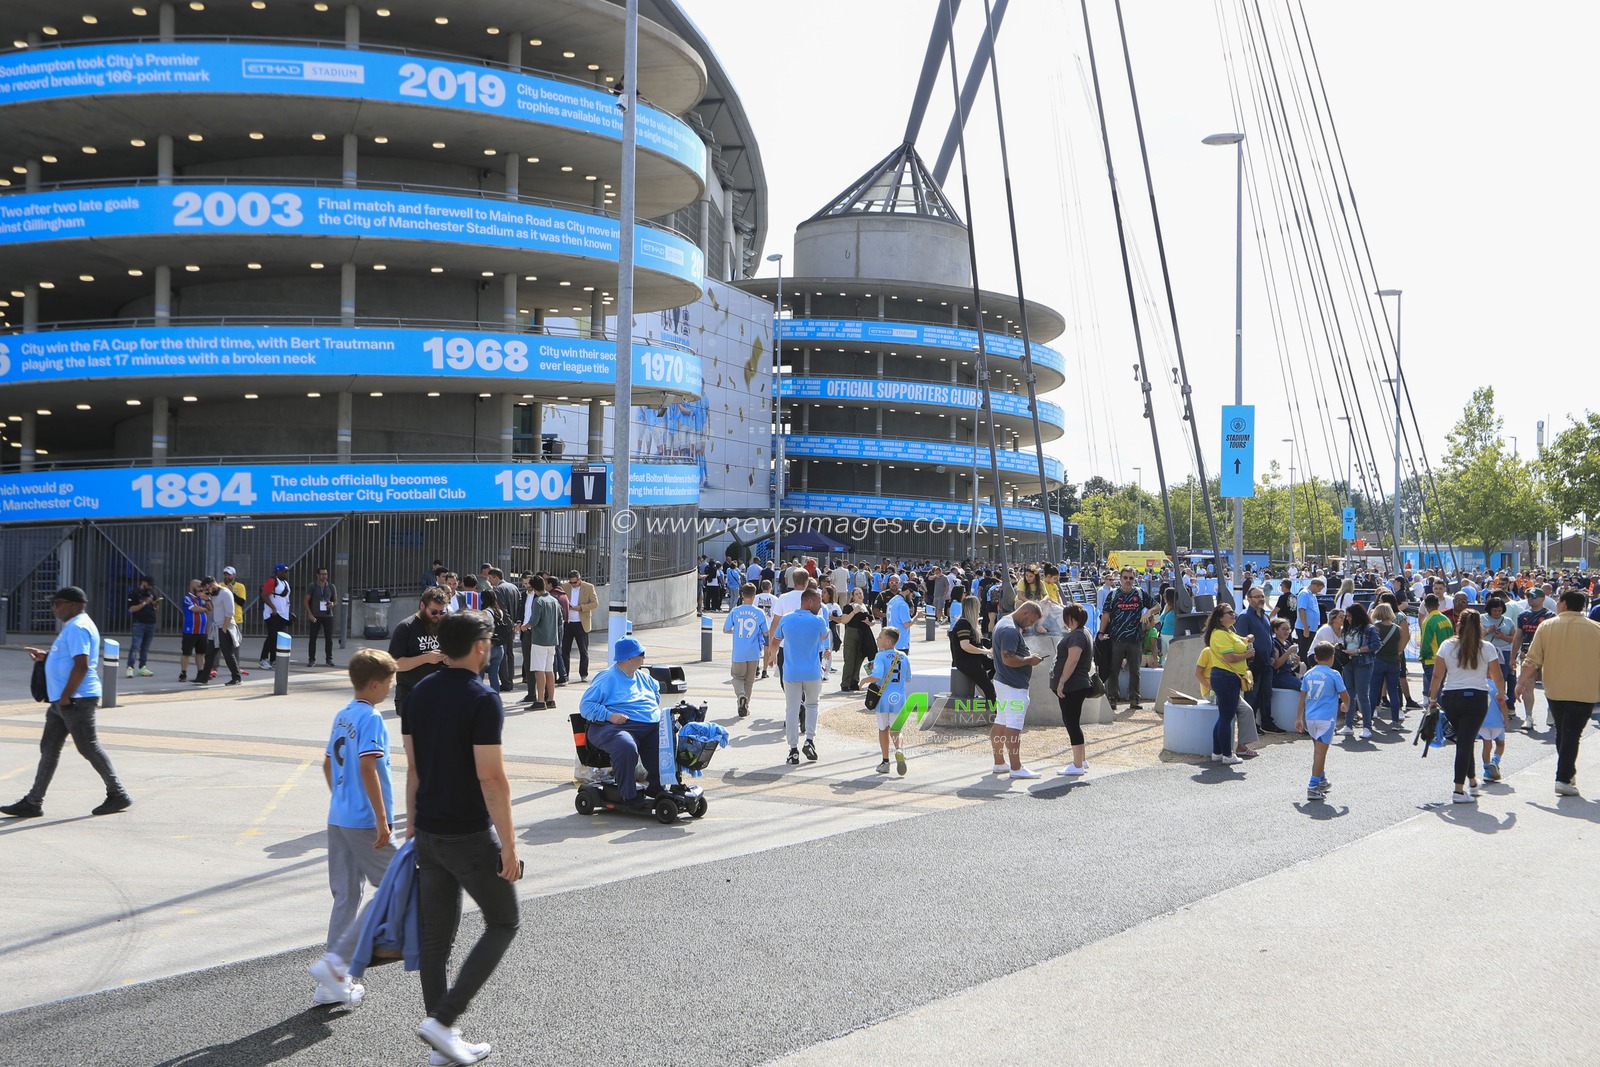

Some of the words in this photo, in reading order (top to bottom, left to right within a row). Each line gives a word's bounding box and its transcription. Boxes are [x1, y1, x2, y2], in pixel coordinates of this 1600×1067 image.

[77, 55, 105, 70] took
[106, 53, 143, 70] City's
[146, 53, 200, 68] Premier
[13, 77, 49, 92] record
[51, 72, 105, 88] breaking
[106, 69, 172, 84] 100-point
[174, 69, 210, 83] mark
[248, 64, 301, 76] ETIHAD
[312, 67, 358, 79] STADIUM
[399, 63, 506, 108] 2019
[517, 83, 538, 99] City
[540, 88, 579, 106] become
[580, 95, 595, 109] the
[596, 100, 613, 115] first
[517, 99, 560, 116] trophies
[562, 107, 601, 125] available
[602, 117, 611, 128] to
[612, 119, 623, 132] the
[1, 206, 22, 218] Two
[24, 204, 52, 216] after
[53, 202, 77, 213] two
[79, 199, 103, 212] late
[104, 197, 139, 213] goals
[173, 191, 303, 227] 2003
[23, 217, 85, 232] Gillingham
[318, 198, 350, 210] Final
[353, 200, 395, 213] match
[398, 203, 422, 215] and
[424, 204, 473, 219] farewell
[476, 209, 487, 220] to
[490, 210, 523, 224] Maine
[525, 214, 552, 227] Road
[554, 220, 565, 229] as
[567, 220, 585, 235] City
[587, 226, 610, 237] move
[318, 213, 341, 225] the
[344, 214, 371, 229] City
[374, 217, 387, 227] of
[389, 217, 464, 233] Manchester
[466, 221, 514, 237] Stadium
[516, 230, 529, 240] as
[531, 230, 538, 240] it
[539, 232, 560, 243] was
[562, 235, 583, 247] then
[584, 239, 612, 251] known
[644, 243, 664, 255] ETIHAD
[21, 343, 45, 356] City
[47, 341, 68, 354] win
[70, 341, 90, 352] the
[93, 340, 110, 352] FA
[112, 339, 138, 353] Cup
[140, 338, 158, 350] for
[160, 338, 183, 349] the
[186, 337, 218, 349] third
[220, 337, 255, 351] time,
[257, 337, 288, 349] with
[291, 338, 320, 349] Bert
[322, 338, 395, 350] Trautmann
[423, 337, 529, 372] 1968
[539, 345, 559, 359] City
[560, 347, 577, 358] win
[579, 348, 599, 360] their
[22, 358, 64, 373] playing
[65, 356, 85, 368] the
[88, 355, 112, 367] last
[114, 354, 129, 366] 17
[131, 354, 186, 366] minutes
[188, 352, 219, 365] with
[221, 355, 230, 364] a
[233, 353, 280, 364] broken
[283, 353, 316, 365] neck
[540, 361, 562, 371] ever
[563, 361, 592, 374] league
[593, 363, 610, 374] title
[641, 352, 684, 384] 1970
[827, 380, 875, 398] OFFICIAL
[877, 383, 949, 403] SUPPORTERS
[950, 388, 983, 408] CLUBS
[1226, 434, 1250, 442] STADIUM
[1229, 441, 1247, 449] TOURS
[271, 475, 298, 487] The
[300, 474, 329, 486] club
[331, 474, 388, 488] officially
[390, 473, 448, 485] becomes
[583, 475, 595, 500] V
[629, 473, 645, 482] efeat
[646, 473, 664, 483] Bolton
[21, 482, 56, 495] would
[58, 484, 74, 496] go
[131, 472, 257, 509] 1894
[272, 489, 354, 502] Manchester
[356, 489, 384, 502] City
[386, 488, 436, 500] Football
[438, 488, 466, 499] Club
[643, 487, 653, 496] the
[653, 486, 664, 496] first
[3, 497, 72, 512] Manchester
[73, 496, 99, 510] City
[1068, 525, 1073, 537] T
[737, 618, 757, 639] 19
[417, 635, 438, 643] WAY
[1307, 679, 1326, 700] 17
